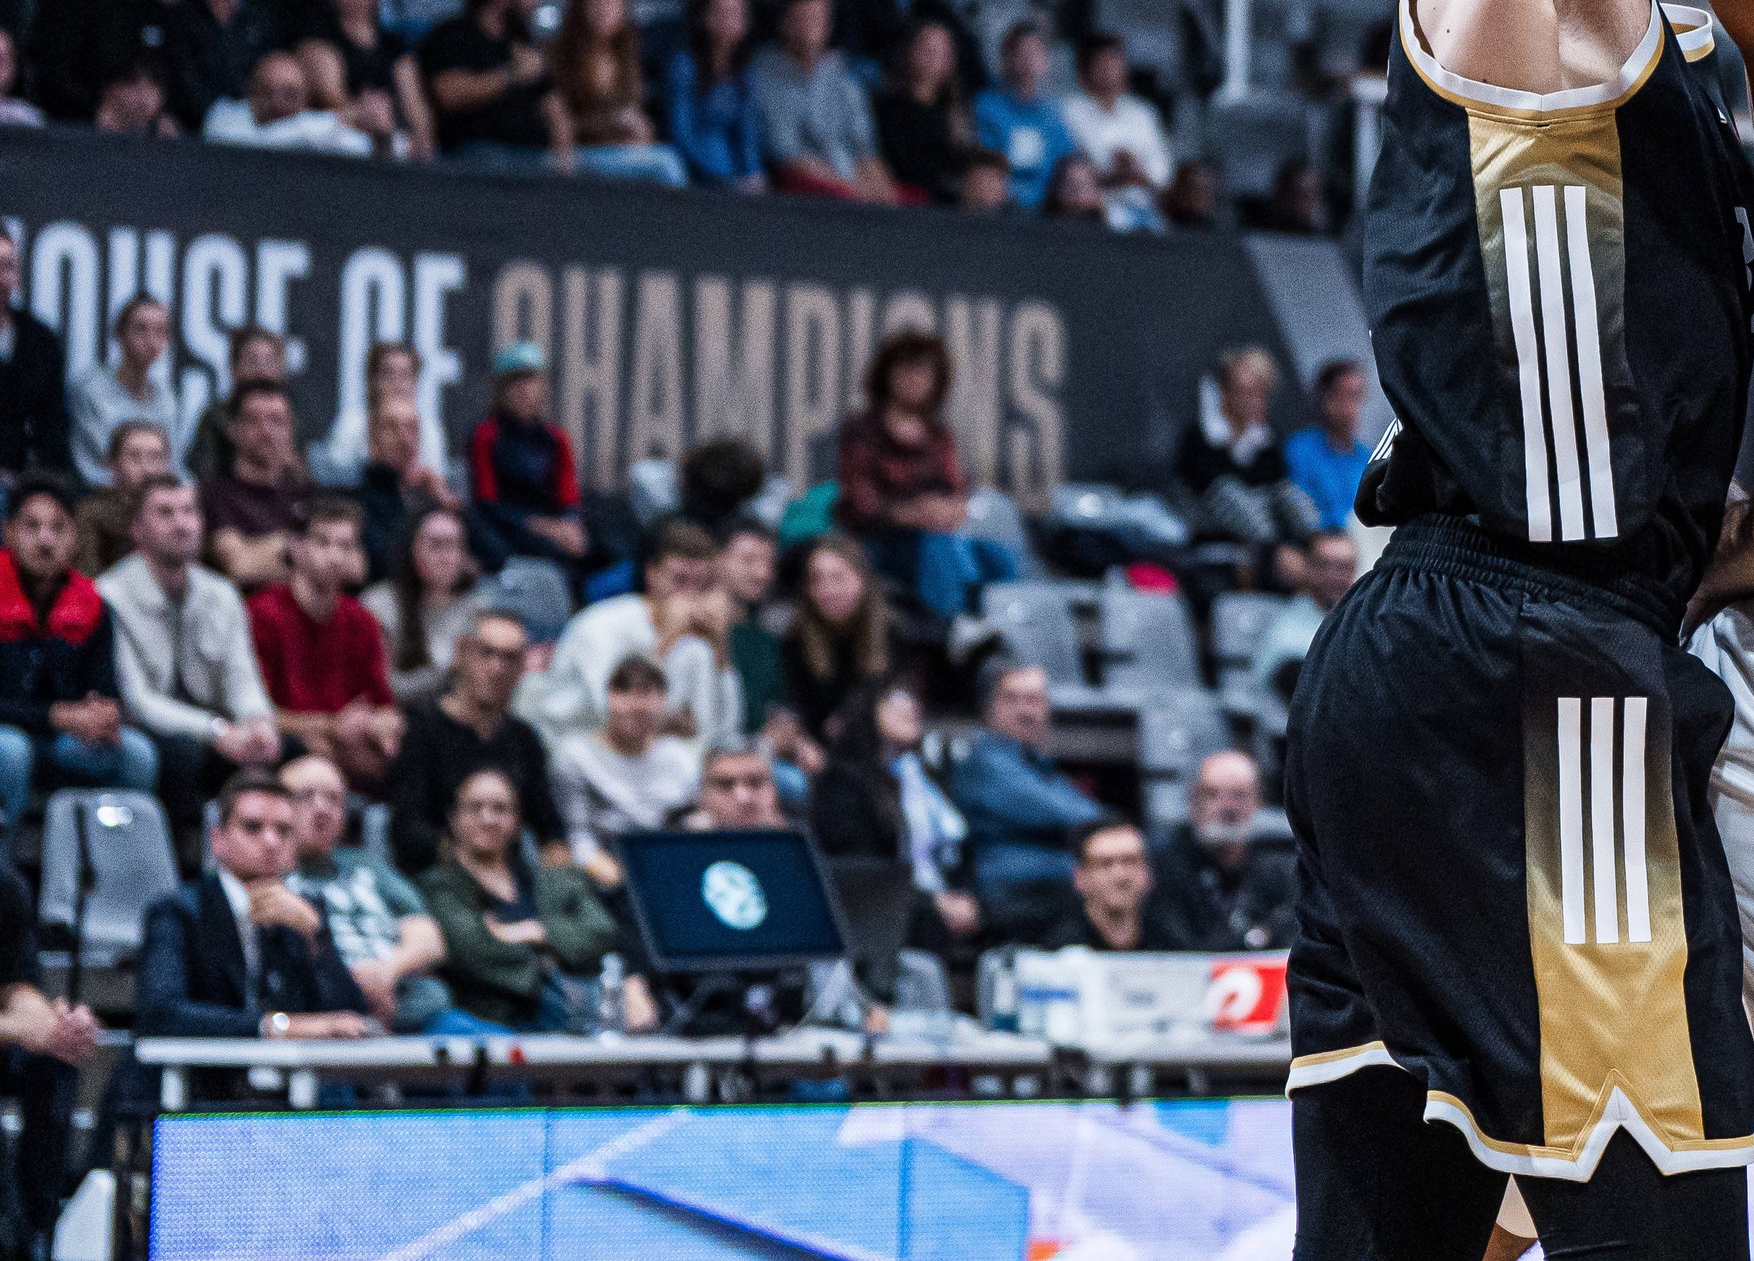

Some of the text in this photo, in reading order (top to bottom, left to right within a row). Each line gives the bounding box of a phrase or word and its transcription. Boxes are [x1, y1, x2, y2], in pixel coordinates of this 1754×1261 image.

[0, 215, 1065, 514] OUSE OF HAMPINS
